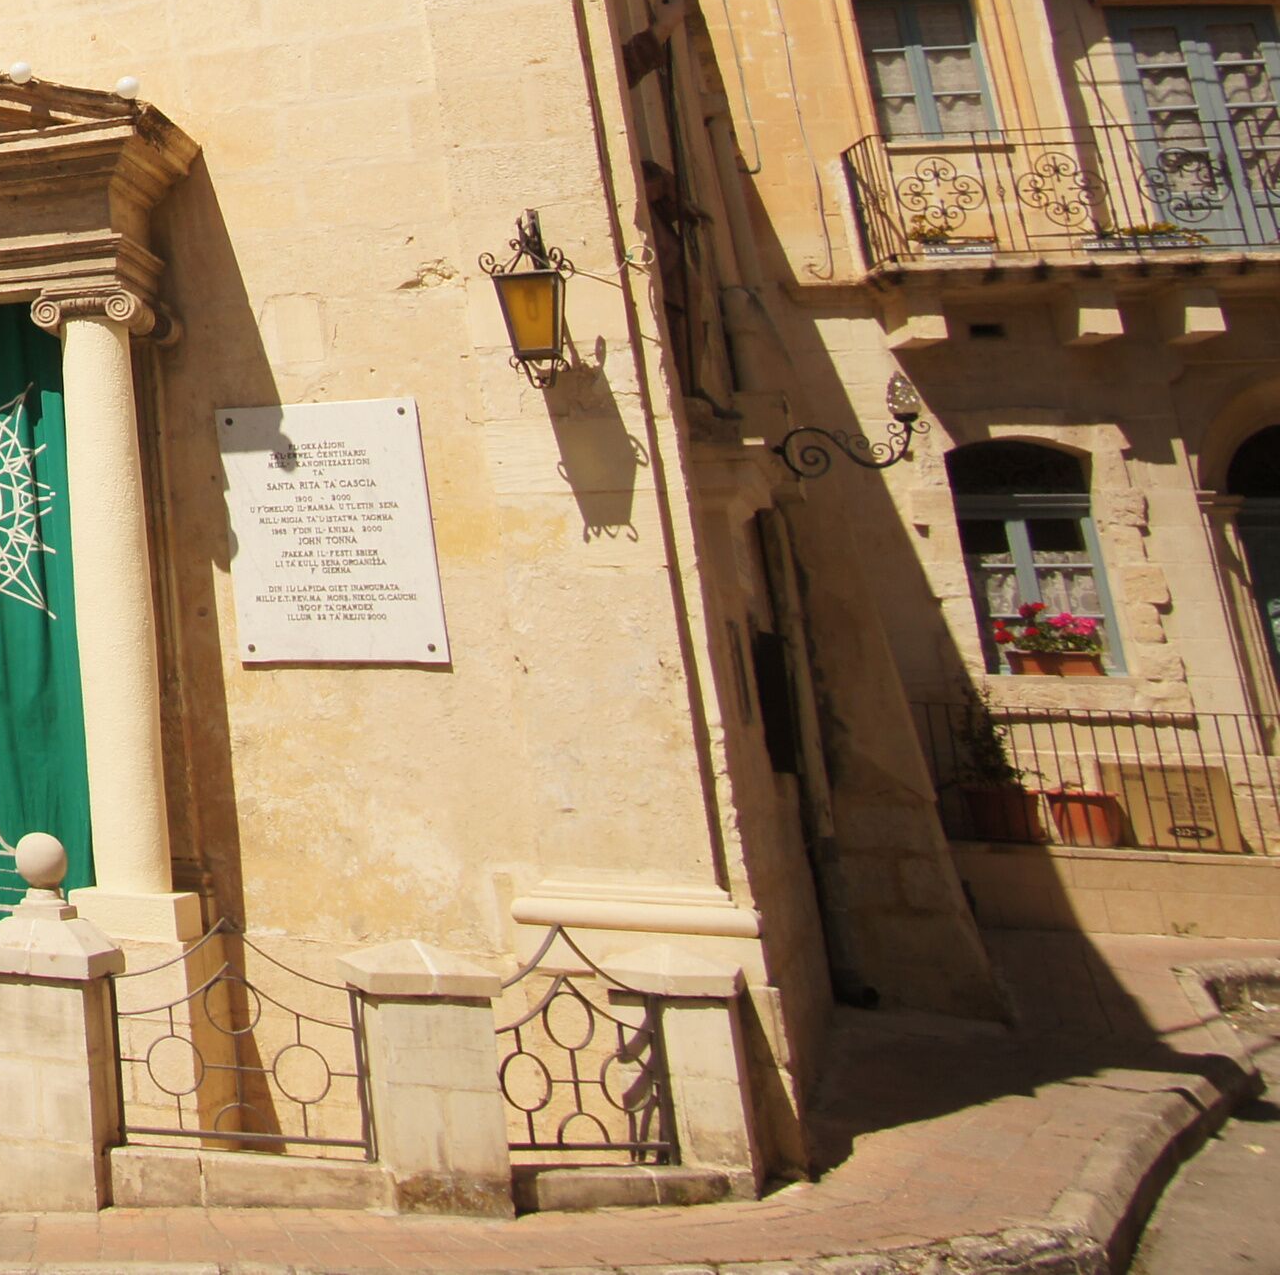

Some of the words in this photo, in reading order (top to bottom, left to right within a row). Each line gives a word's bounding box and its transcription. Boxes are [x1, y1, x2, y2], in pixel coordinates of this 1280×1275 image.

[267, 482, 294, 490] SANTA
[300, 481, 320, 489] RITA
[339, 479, 376, 488] CASCIA
[298, 537, 321, 545] JOHN
[326, 536, 357, 544] TONNA
